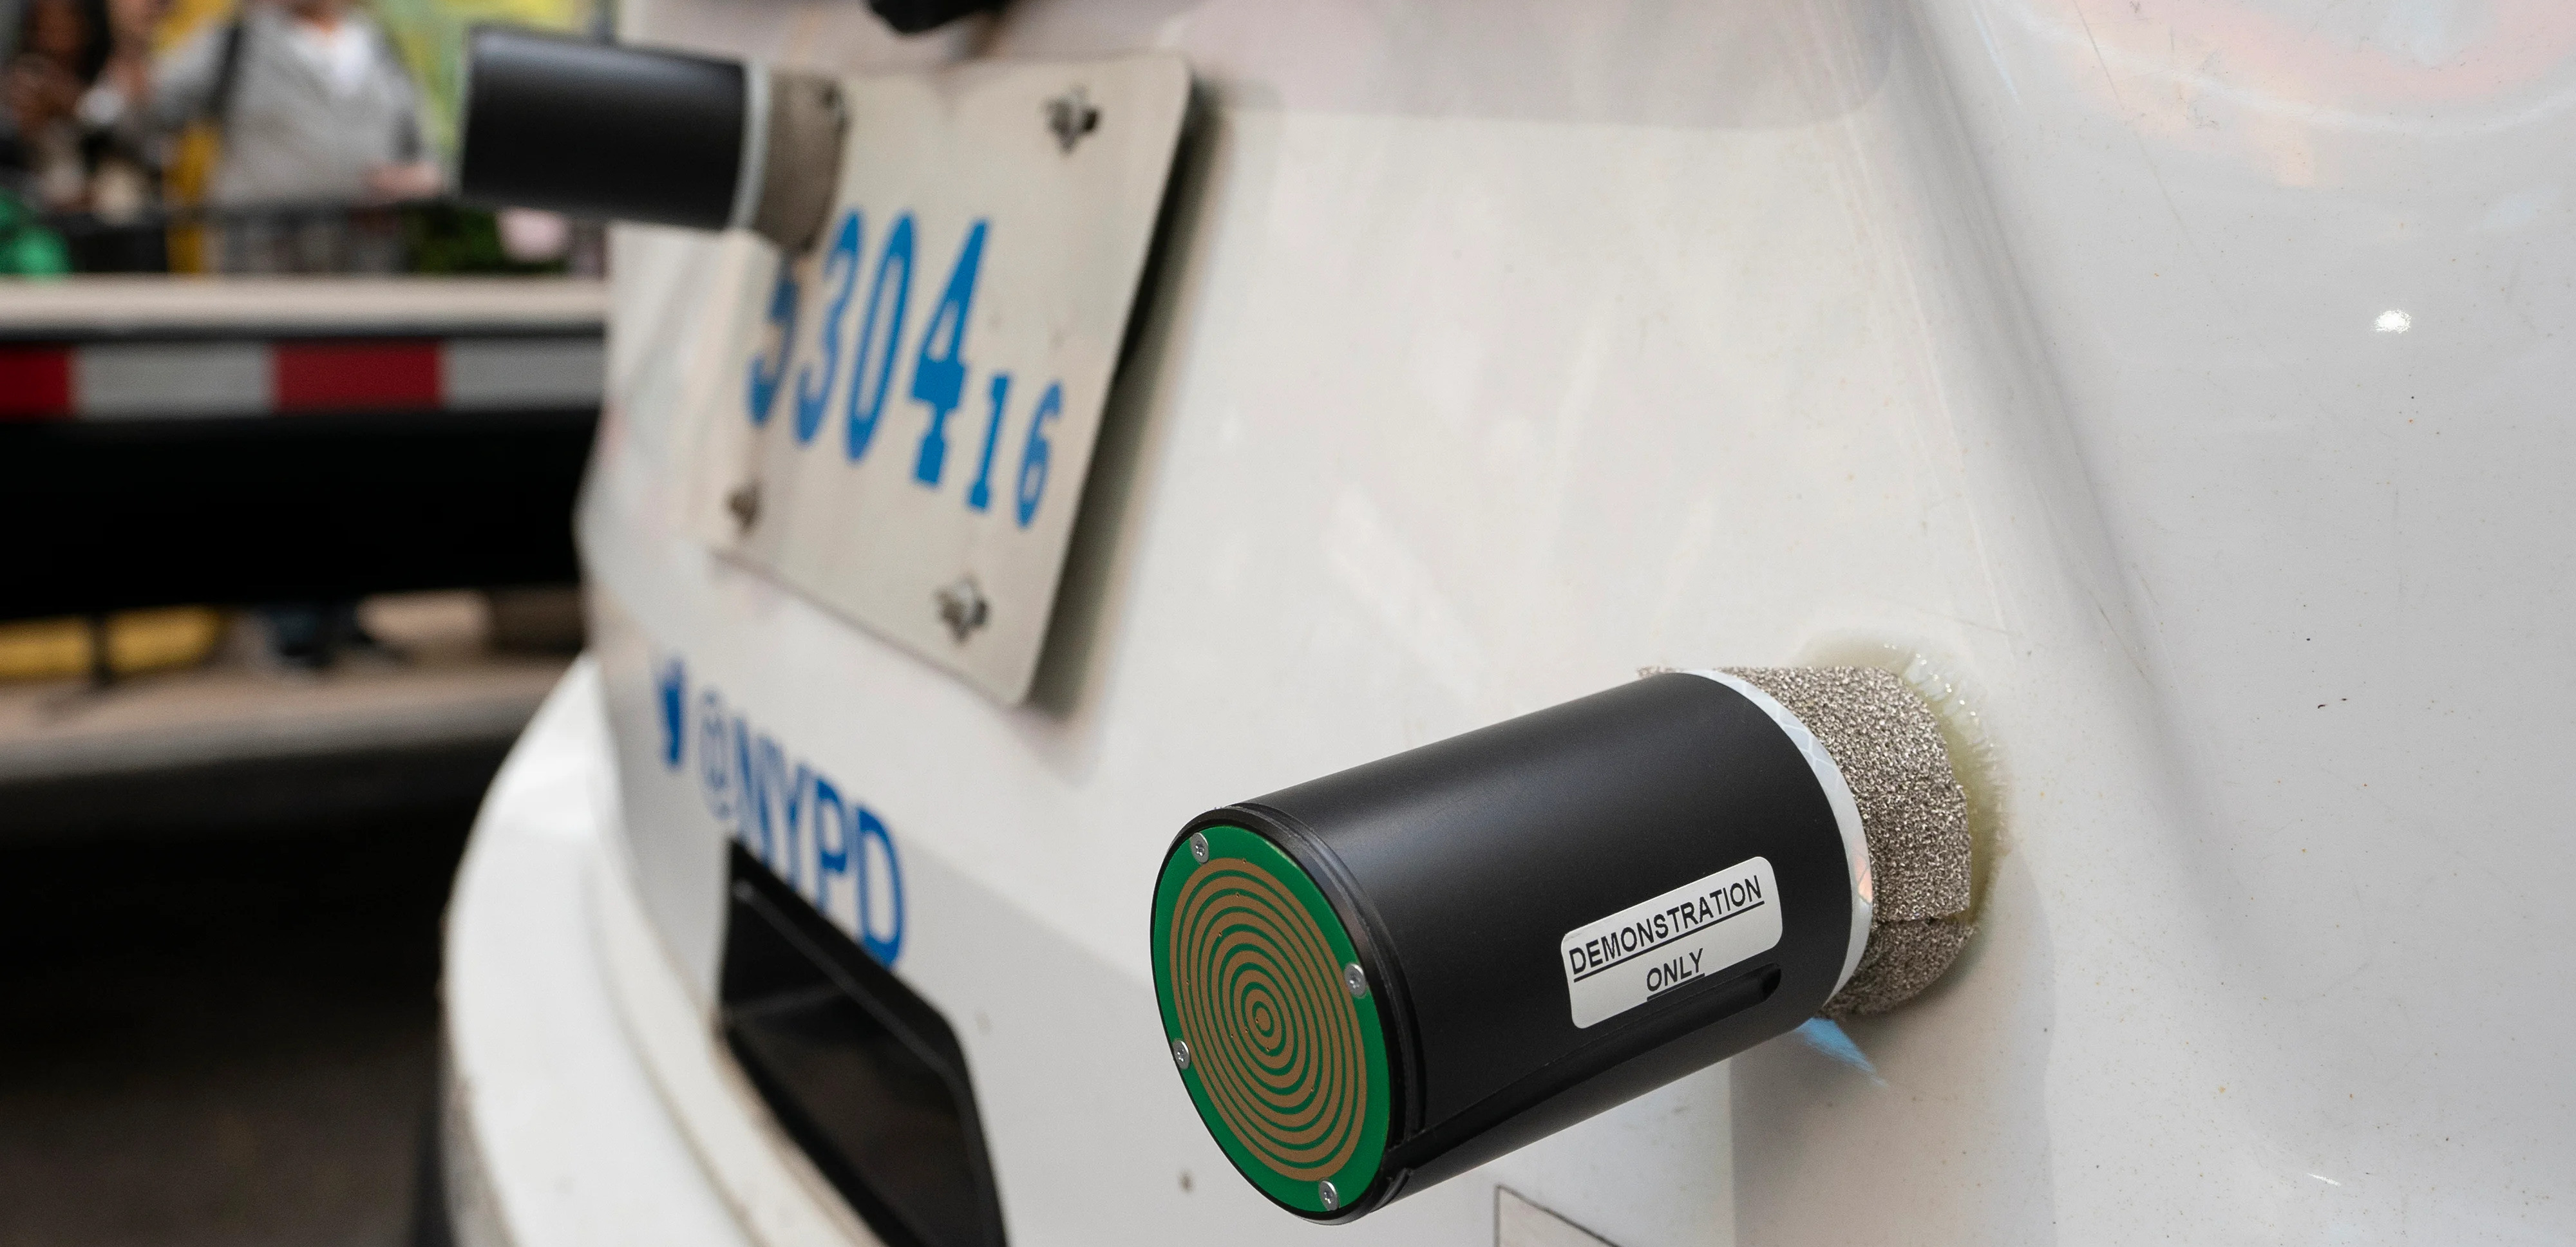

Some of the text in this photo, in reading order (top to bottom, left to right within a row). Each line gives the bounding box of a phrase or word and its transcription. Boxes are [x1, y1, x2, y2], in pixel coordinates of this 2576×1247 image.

[965, 371, 1063, 529] 16
[699, 691, 907, 971] @NYPD
[1569, 875, 1762, 975] DEMONSTRATION
[1647, 948, 1703, 991] ONLY
